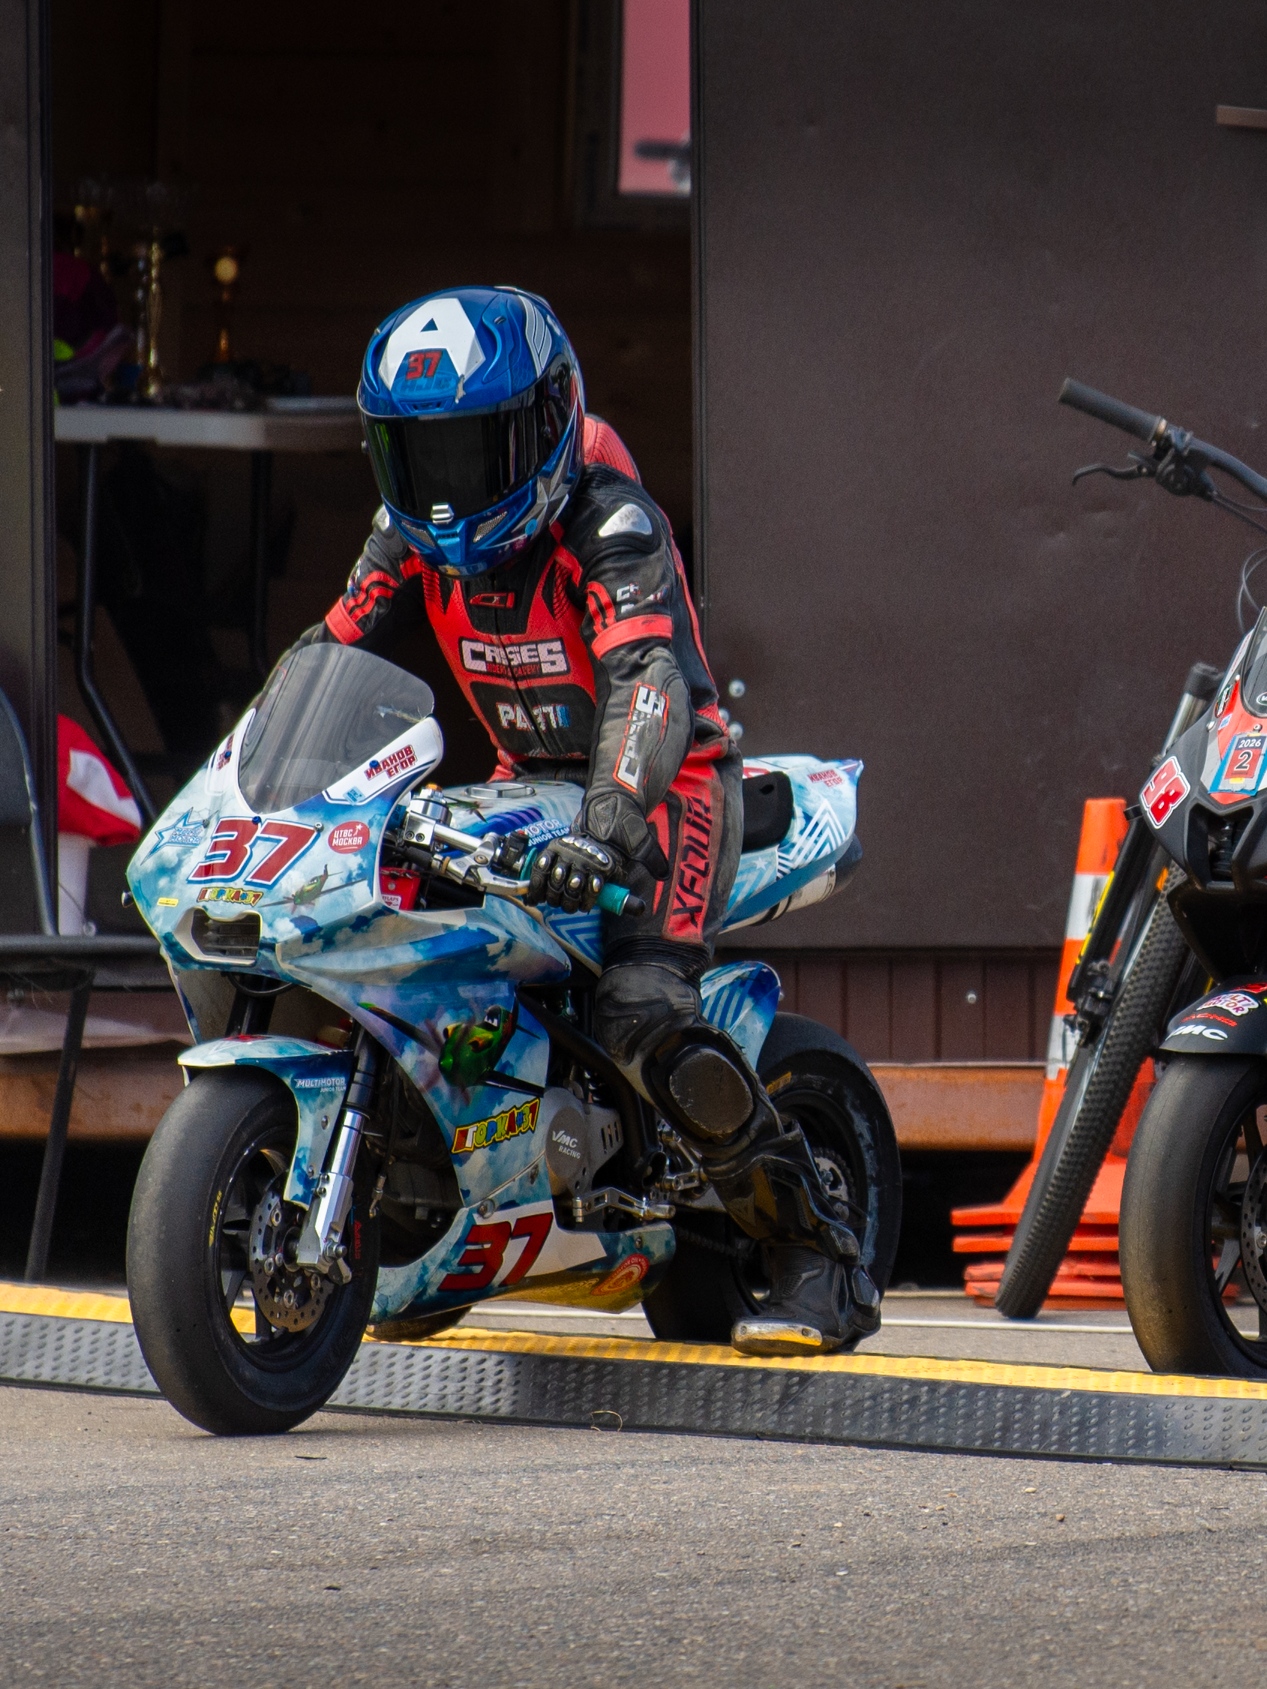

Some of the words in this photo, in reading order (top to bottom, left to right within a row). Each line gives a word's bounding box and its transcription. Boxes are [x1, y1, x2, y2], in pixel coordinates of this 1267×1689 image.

[405, 350, 443, 381] 37
[1238, 739, 1262, 749] 2026
[364, 745, 414, 780] ИВАНОВ
[386, 755, 417, 779] ЕГОР
[1234, 750, 1253, 771] 2
[553, 827, 570, 837] TEAM
[332, 837, 363, 847] МОСКВА
[187, 816, 324, 889] 37
[294, 1077, 346, 1088] MULTIMOTOR
[552, 1130, 578, 1148] VMC
[558, 1146, 581, 1159] RACING
[438, 1212, 553, 1291] 37
